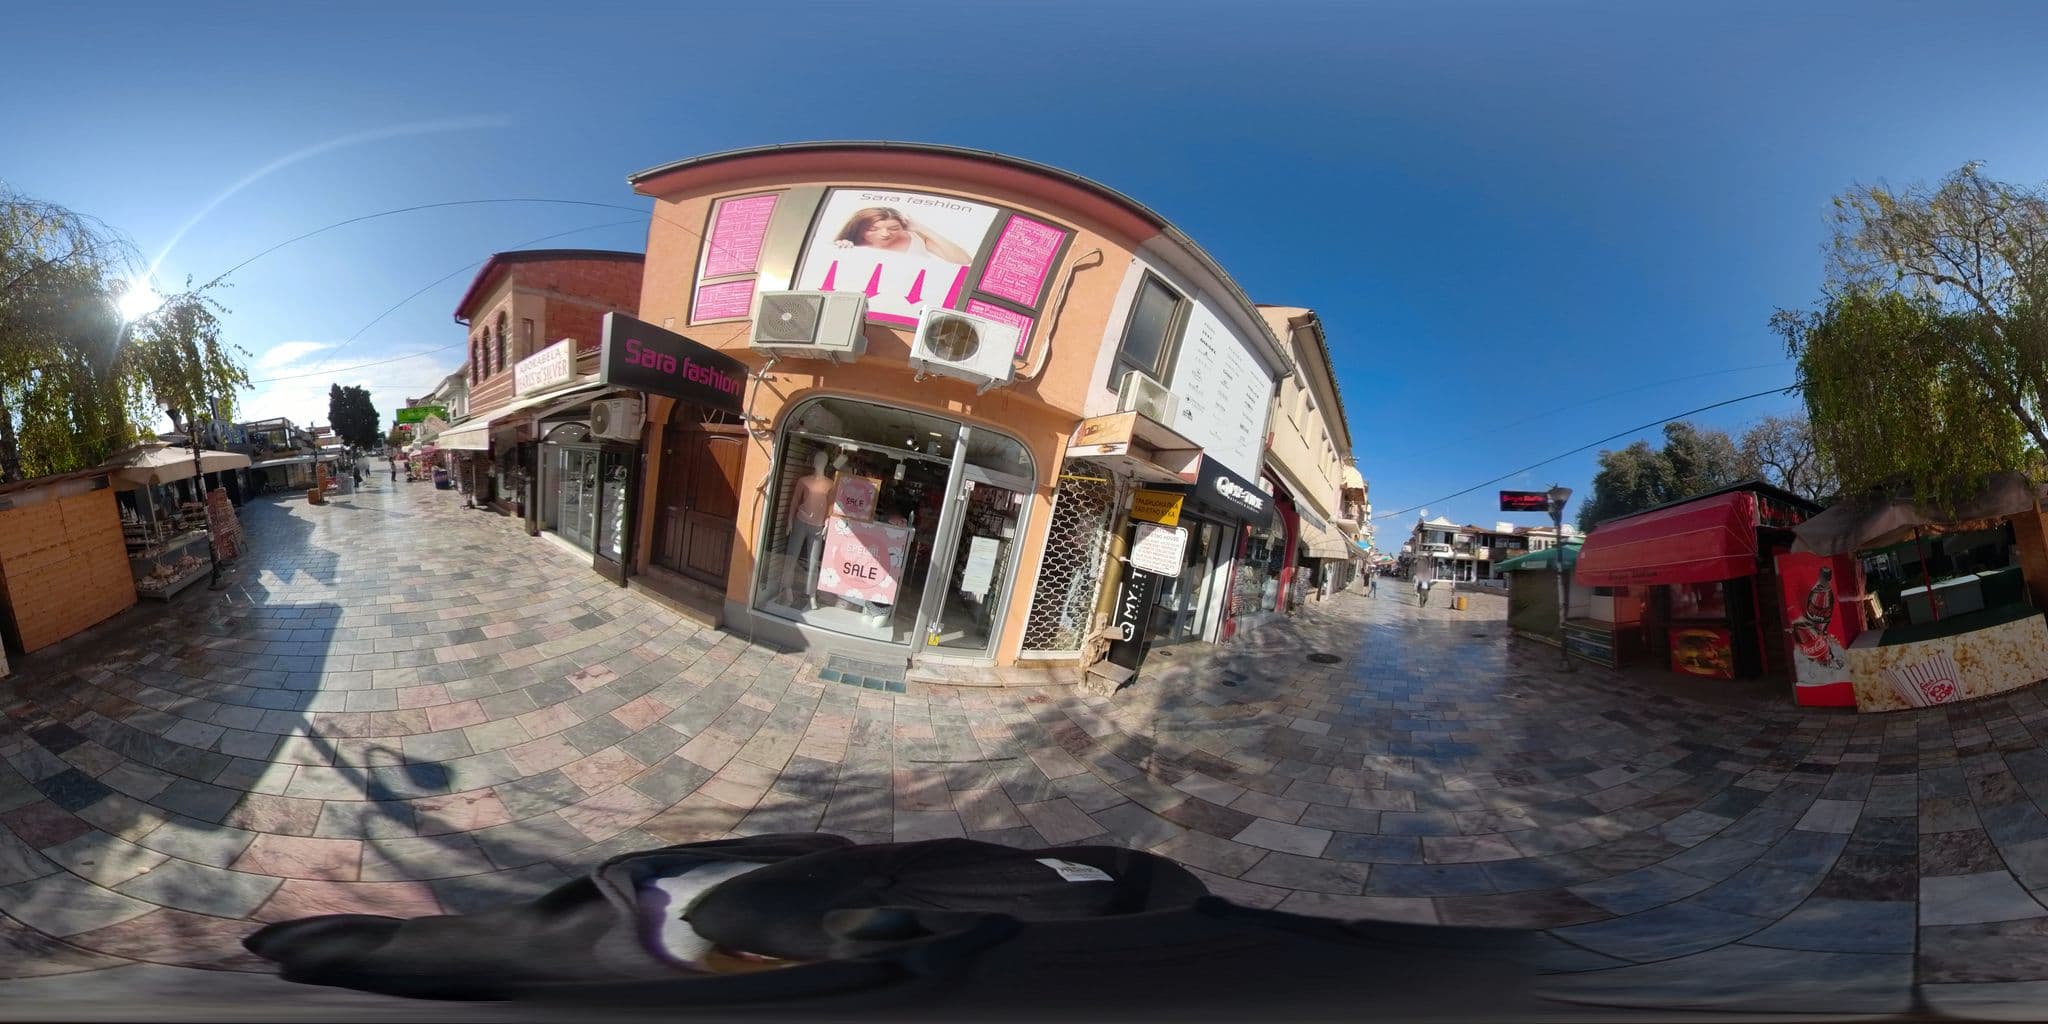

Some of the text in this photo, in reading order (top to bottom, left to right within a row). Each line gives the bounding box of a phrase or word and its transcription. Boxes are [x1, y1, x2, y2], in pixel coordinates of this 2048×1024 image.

[859, 193, 973, 213] Sara fashion
[543, 358, 568, 383] SILVER
[623, 338, 740, 396] Sara fashion
[845, 497, 865, 507] SALE
[843, 562, 878, 580] SALE
